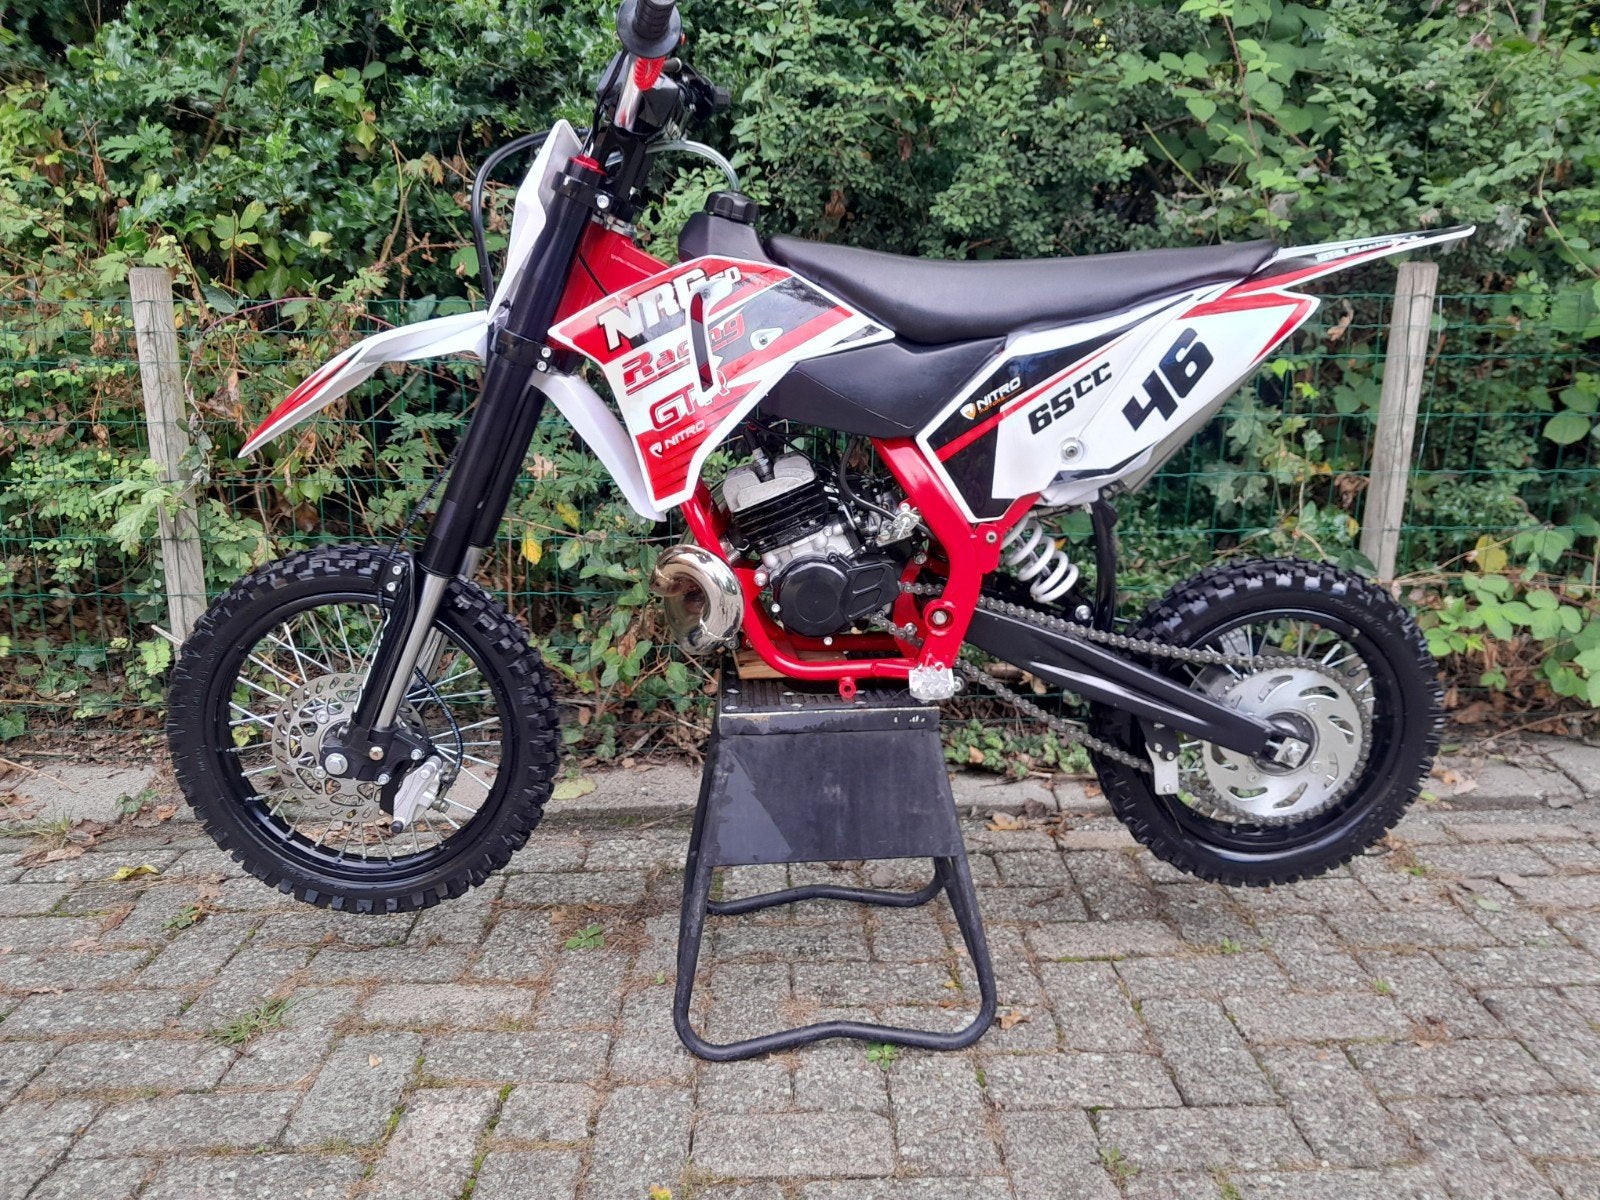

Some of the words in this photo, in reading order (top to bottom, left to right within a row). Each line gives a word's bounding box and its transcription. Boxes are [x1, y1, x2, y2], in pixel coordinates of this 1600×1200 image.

[622, 312, 745, 388] Racng
[1121, 327, 1215, 431] 46
[975, 376, 1021, 411] NITRO
[1028, 361, 1113, 435] 65CC
[664, 419, 706, 450] NITRO
